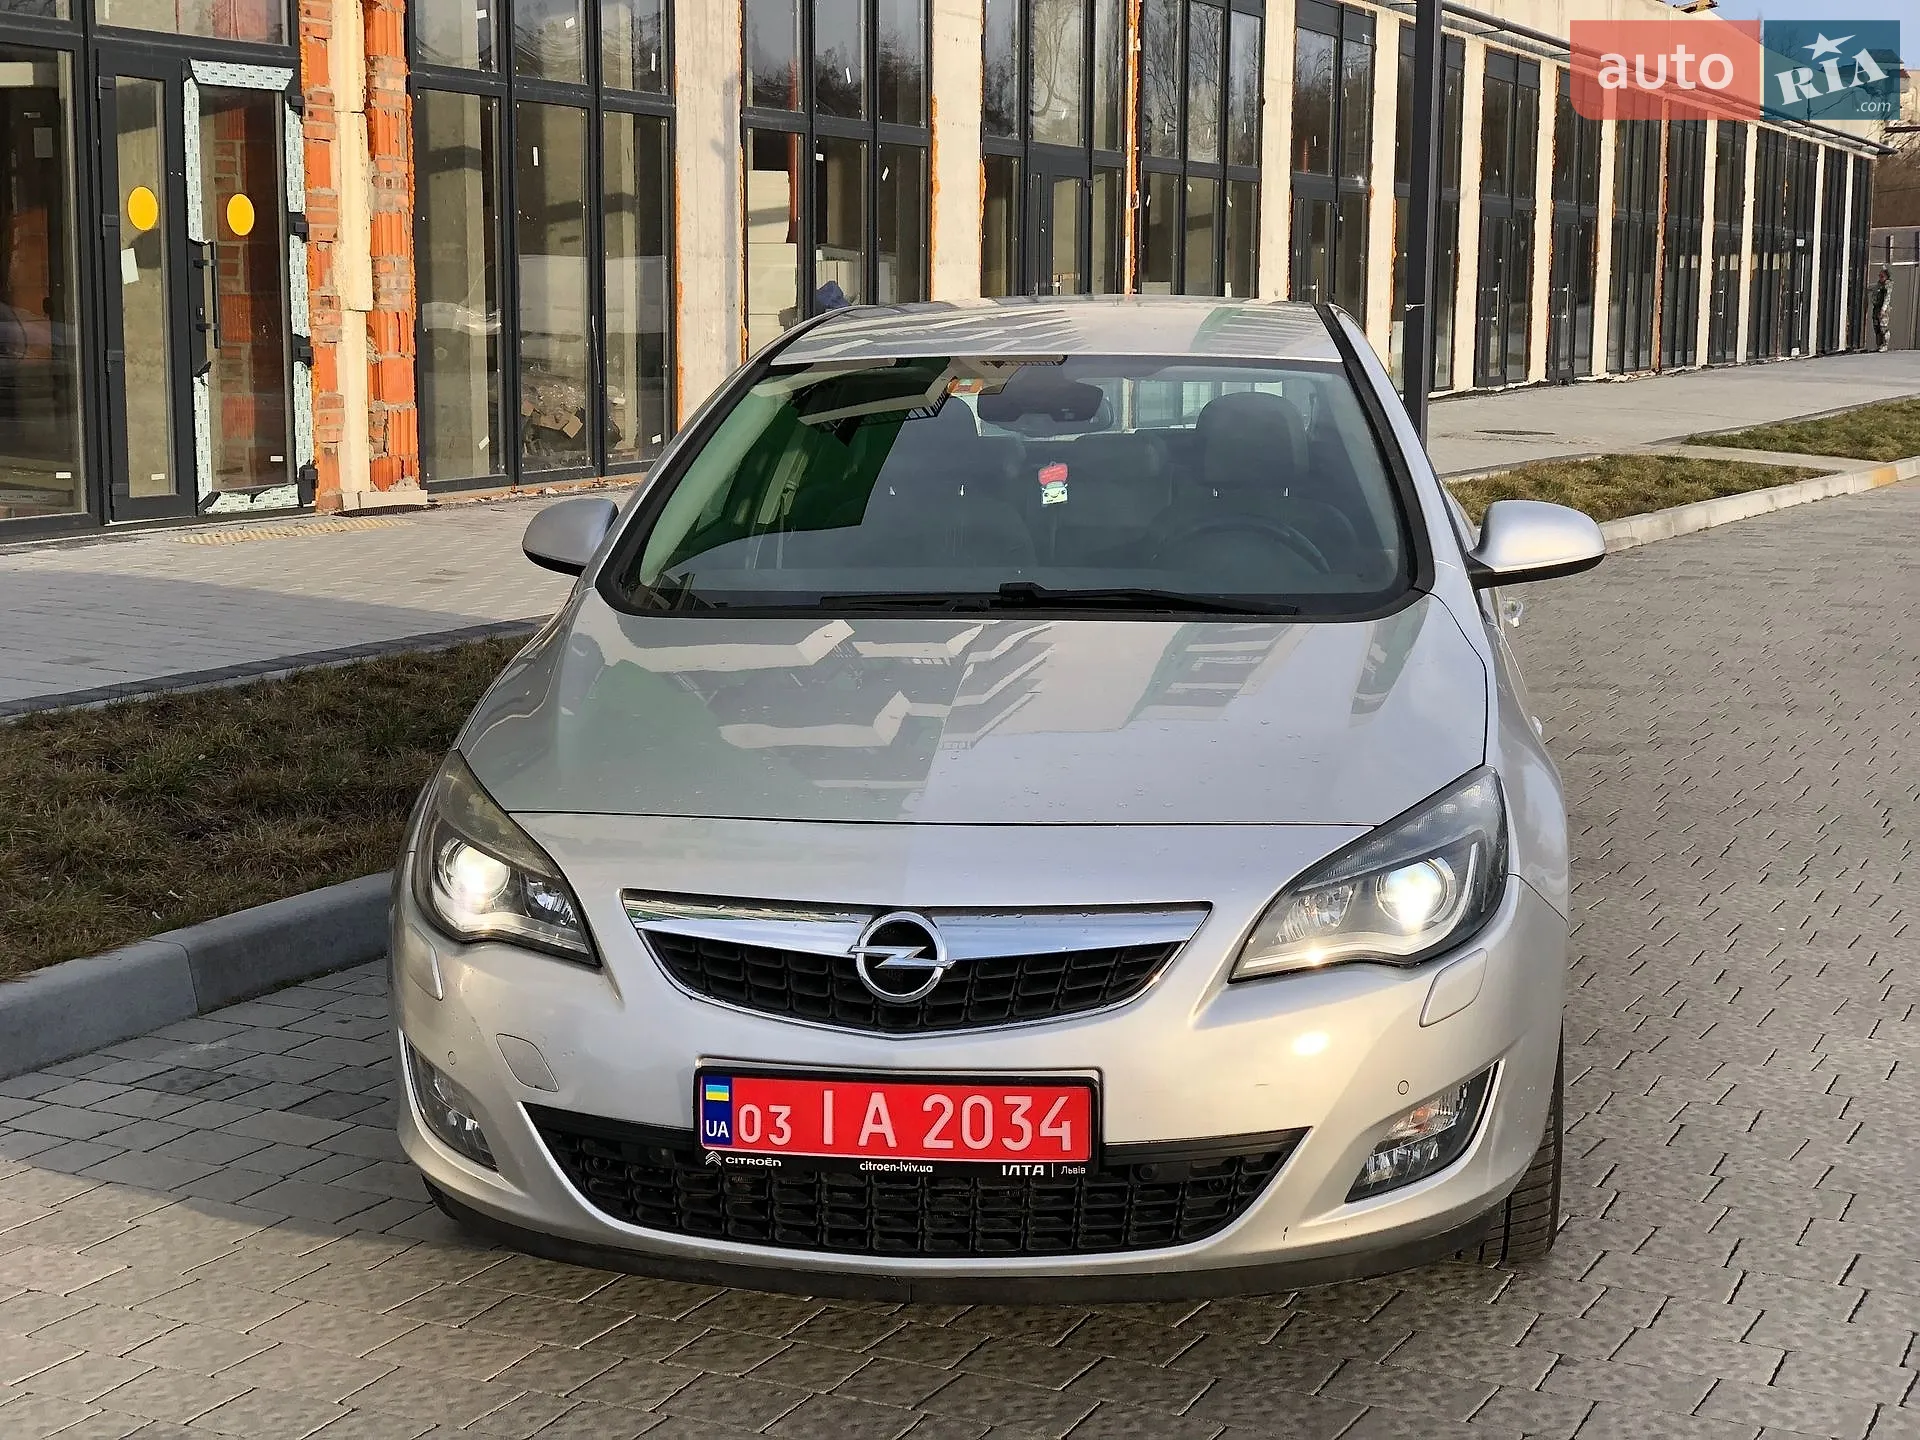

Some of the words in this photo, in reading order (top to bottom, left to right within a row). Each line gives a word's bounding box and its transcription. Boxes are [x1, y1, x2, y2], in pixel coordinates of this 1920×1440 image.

[705, 1119, 730, 1138] UA
[738, 1103, 792, 1146] 03
[921, 1093, 1073, 1152] 2034
[859, 1160, 934, 1173] citroen-lviv.ua
[1060, 1165, 1086, 1175] Львів
